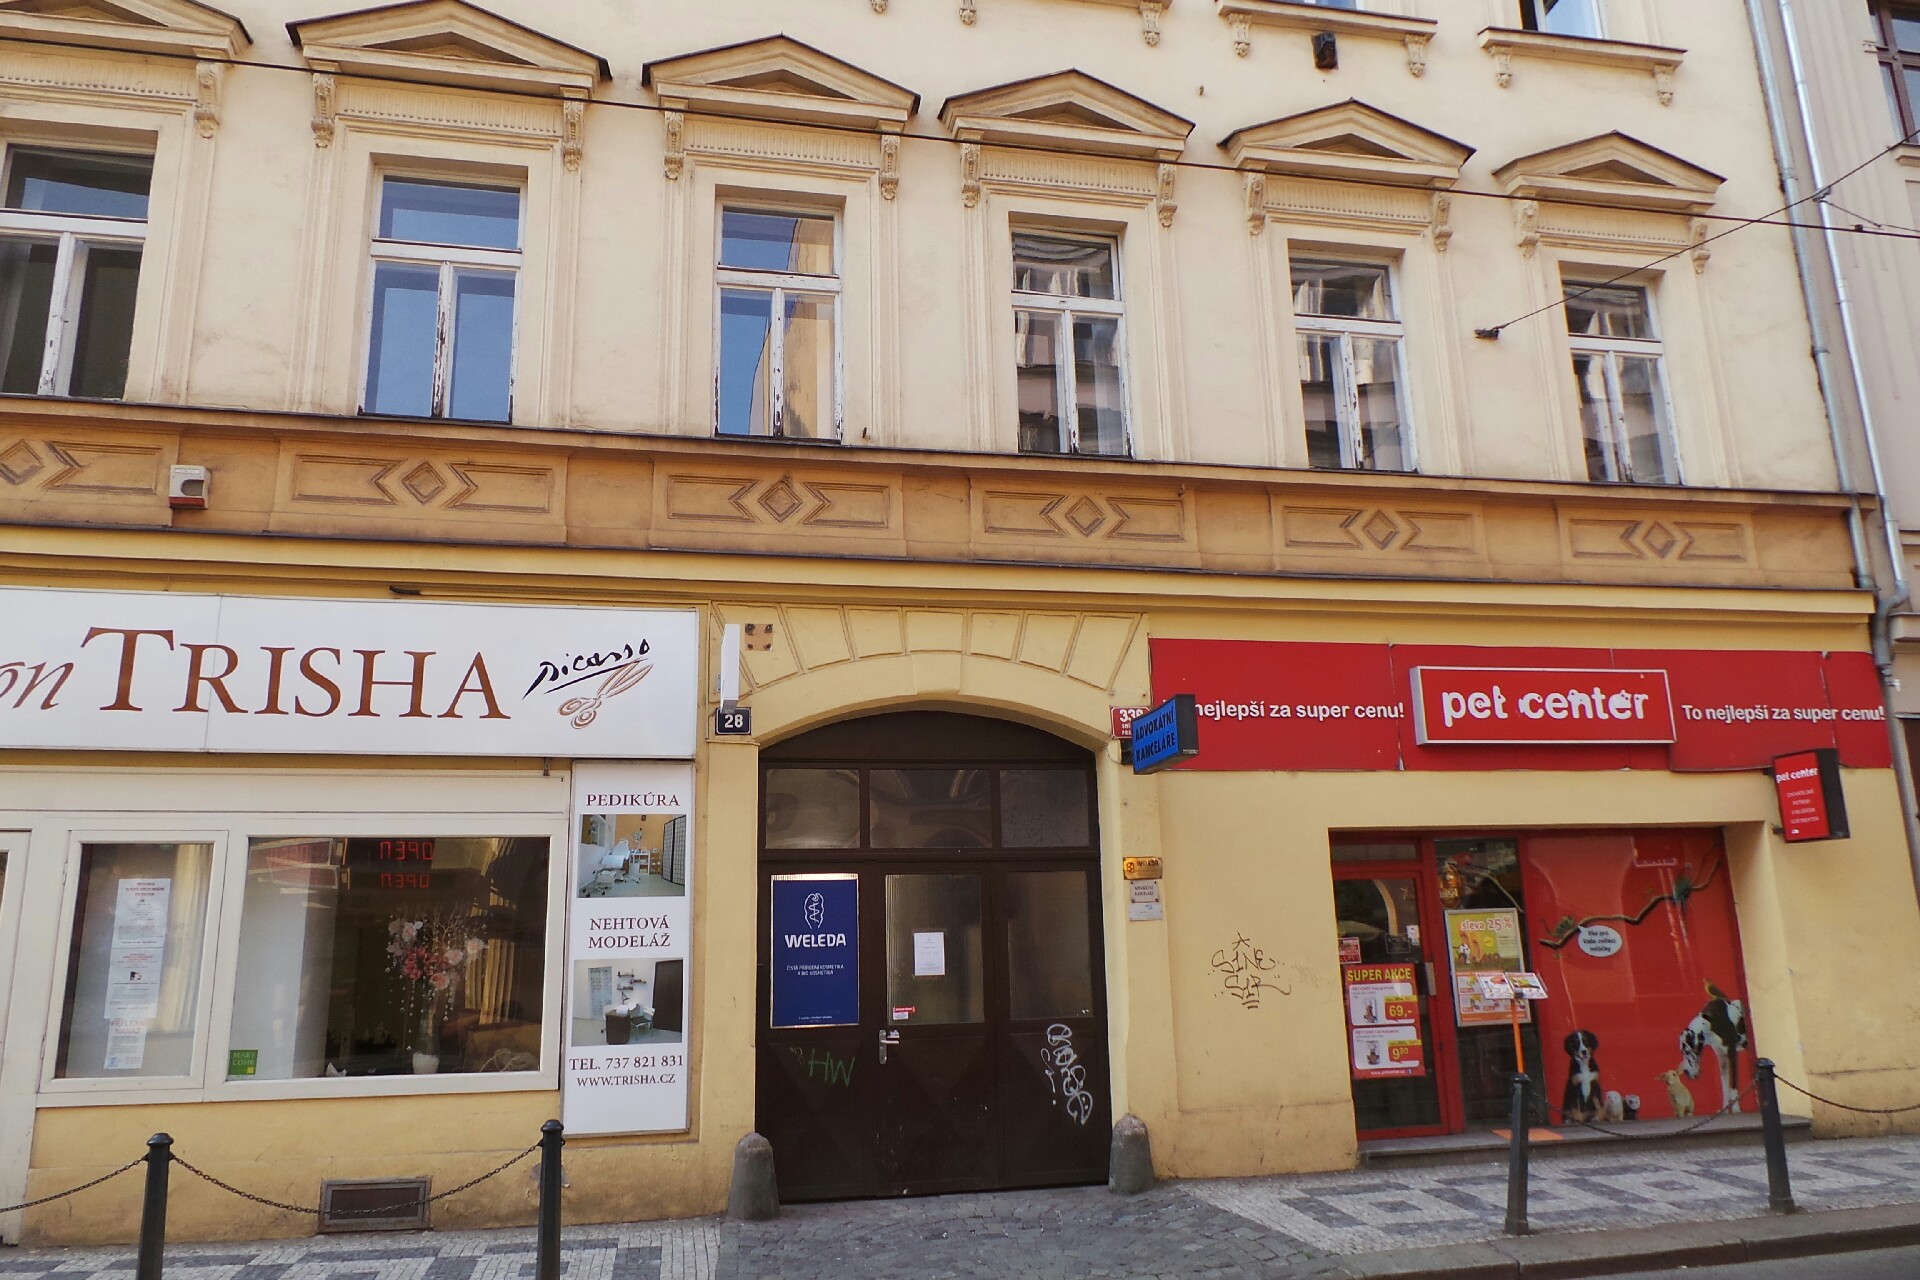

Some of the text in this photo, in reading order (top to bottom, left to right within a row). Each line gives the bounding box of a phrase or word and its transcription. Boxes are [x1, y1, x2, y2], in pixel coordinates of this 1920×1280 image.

[80, 626, 512, 720] TRISHA
[1269, 703, 1291, 718] za
[1296, 704, 1350, 722] super
[1354, 702, 1405, 719] cenu!
[1441, 685, 1649, 728] pet center
[1681, 704, 1886, 724] To nejlepší za super cenu!
[724, 714, 744, 728] 28
[1135, 705, 1175, 743] ADVOKÁTNÍ
[1136, 731, 1176, 763] KANCELÁŘE
[1776, 767, 1818, 784] pet center
[586, 792, 680, 807] PEDIKÚRA
[590, 915, 670, 931] NEHTOVÁ
[1461, 916, 1512, 931] sleva 25 %
[588, 933, 671, 949] MODELÁŽ
[784, 933, 847, 948] WELEDA
[1347, 967, 1412, 981] SUPER AKCE
[569, 1055, 684, 1071] TEL. 737 821 831
[577, 1073, 676, 1087] WWW.TRISHA.CZ
